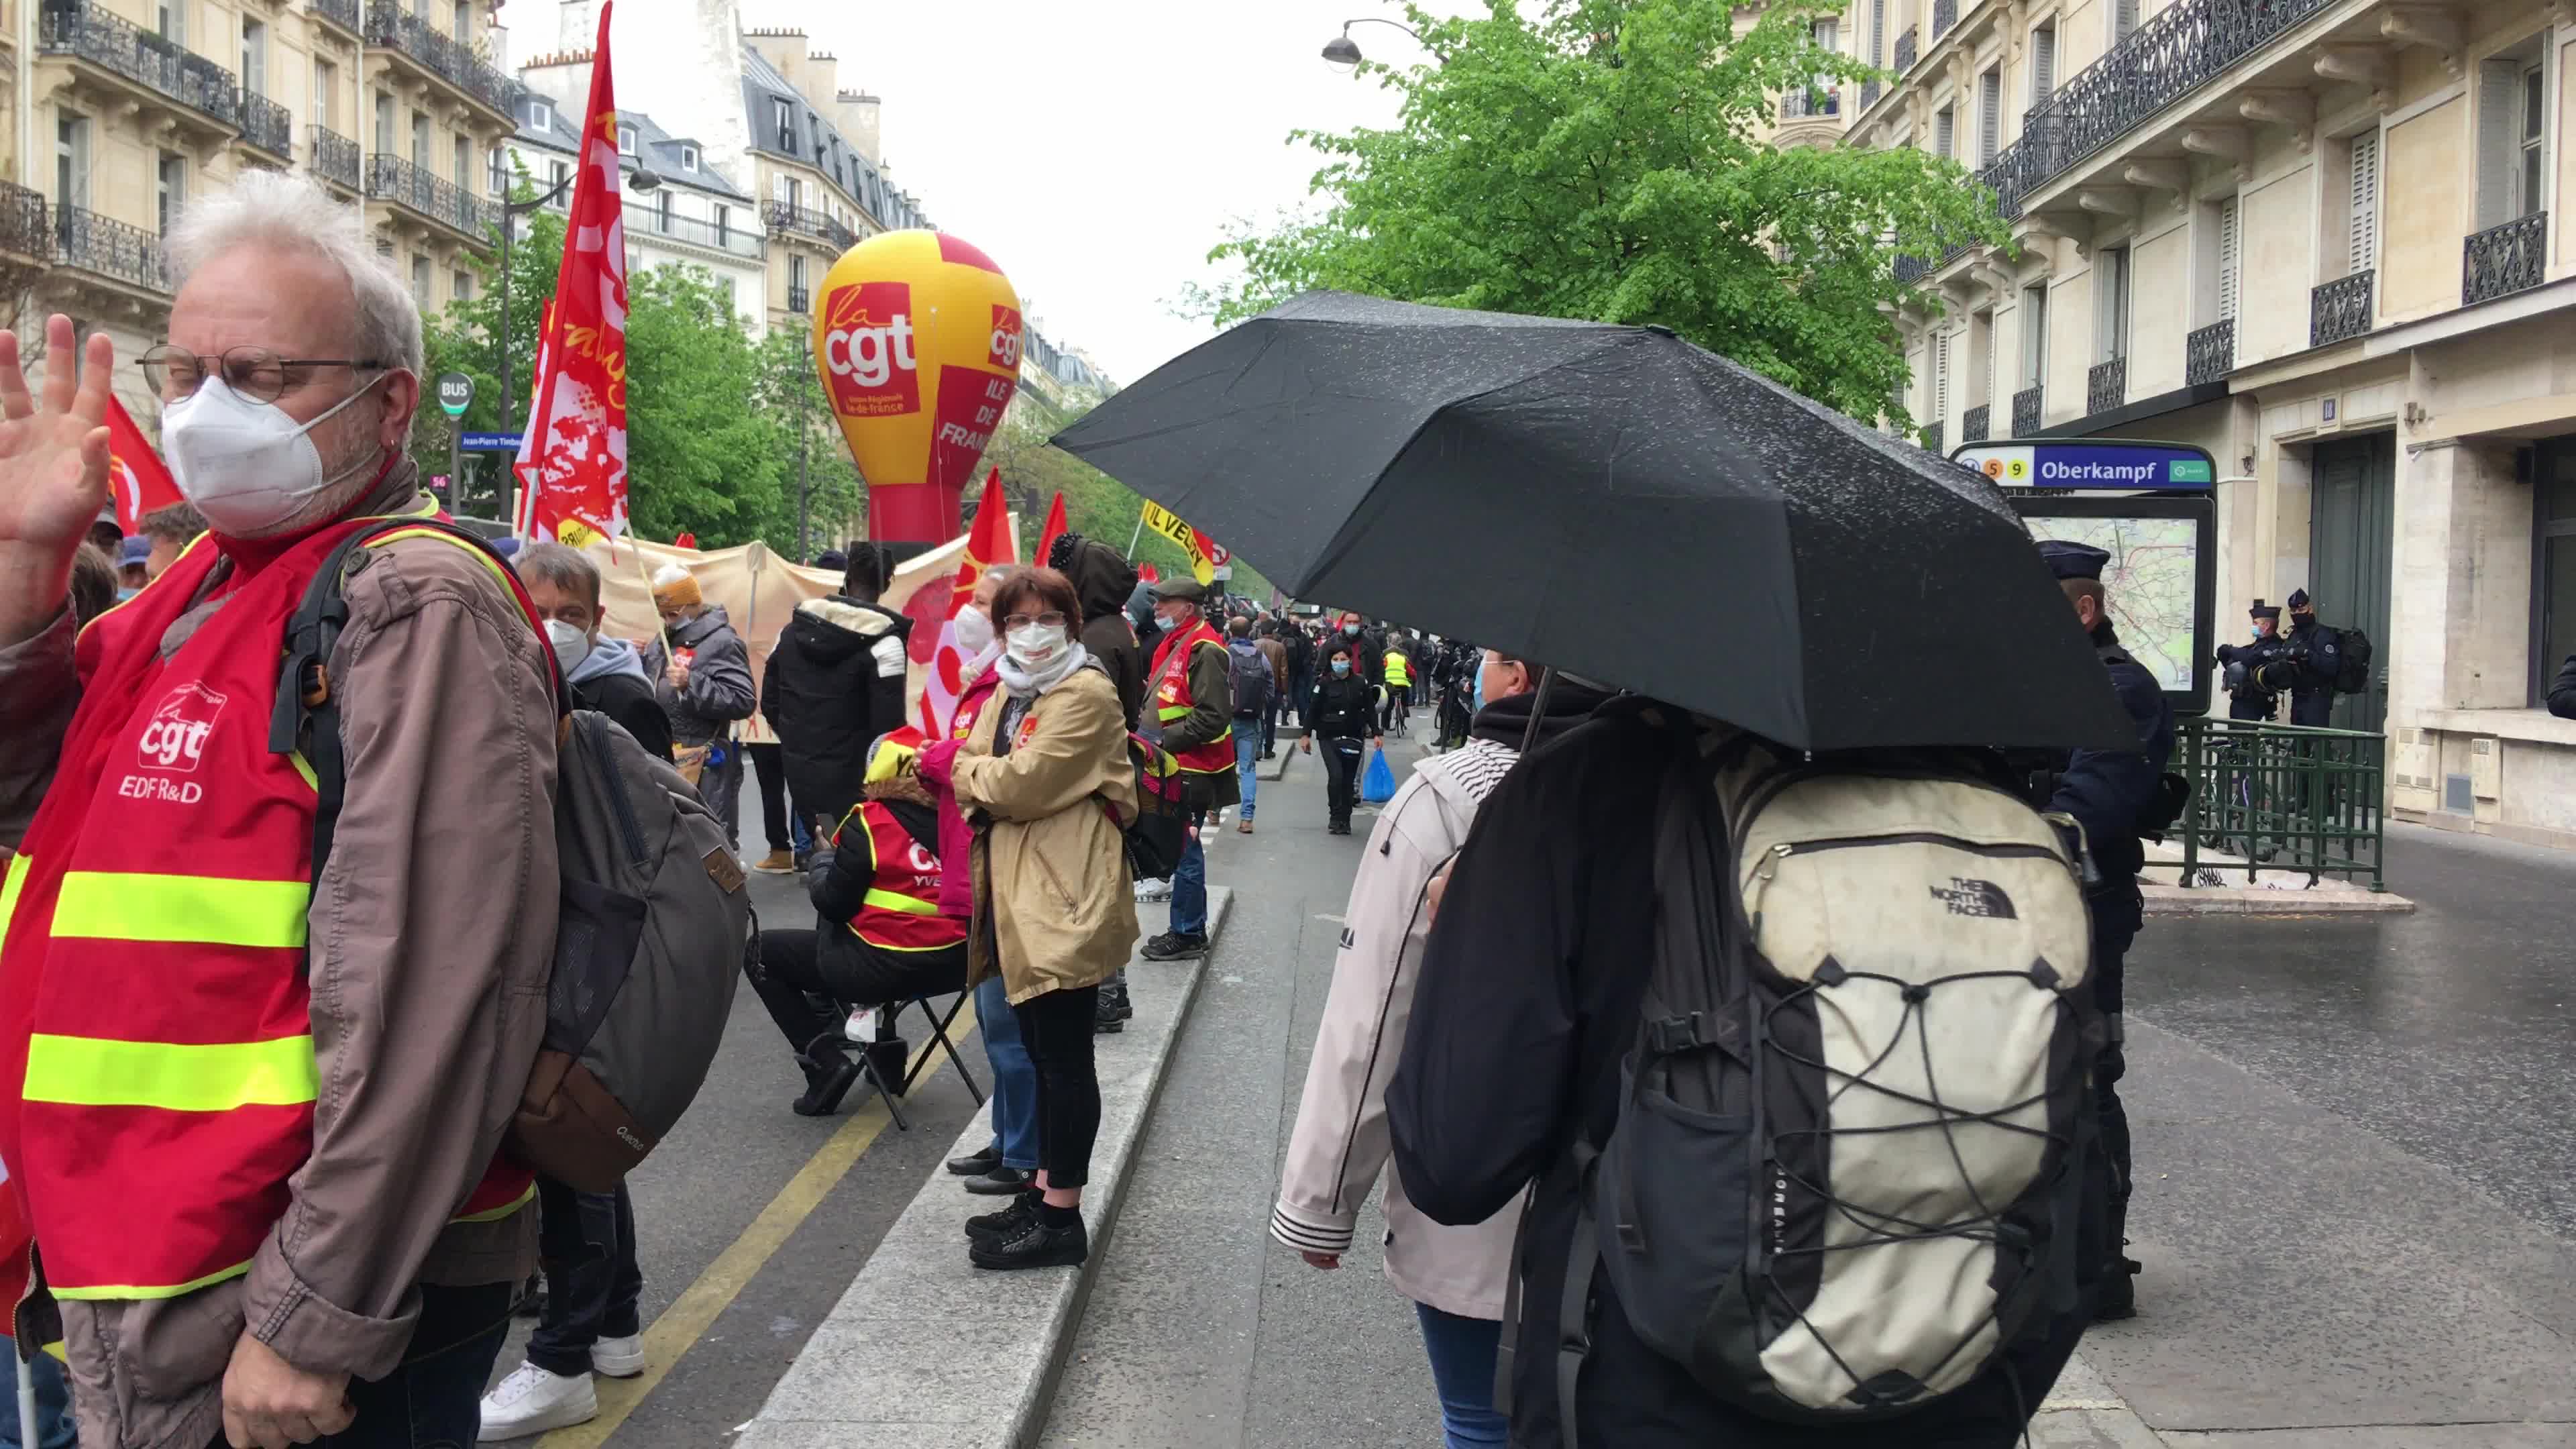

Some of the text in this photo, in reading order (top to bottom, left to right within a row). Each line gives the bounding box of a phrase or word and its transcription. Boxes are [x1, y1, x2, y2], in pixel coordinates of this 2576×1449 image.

[826, 315, 916, 386] cgt
[441, 382, 468, 396] BUS
[985, 378, 1007, 400] ILE
[975, 405, 997, 426] DE
[463, 437, 498, 447] Jean-Pierre
[433, 477, 446, 487] 56
[1989, 463, 1998, 474] 5
[2012, 463, 2021, 475] 9
[2041, 462, 2157, 484] Oberkampf
[140, 720, 211, 765] cgt
[119, 775, 202, 803] EDF R&D
[1929, 885, 1982, 904] NORTH
[1950, 877, 1982, 892] THE
[1948, 902, 1988, 917] FACE
